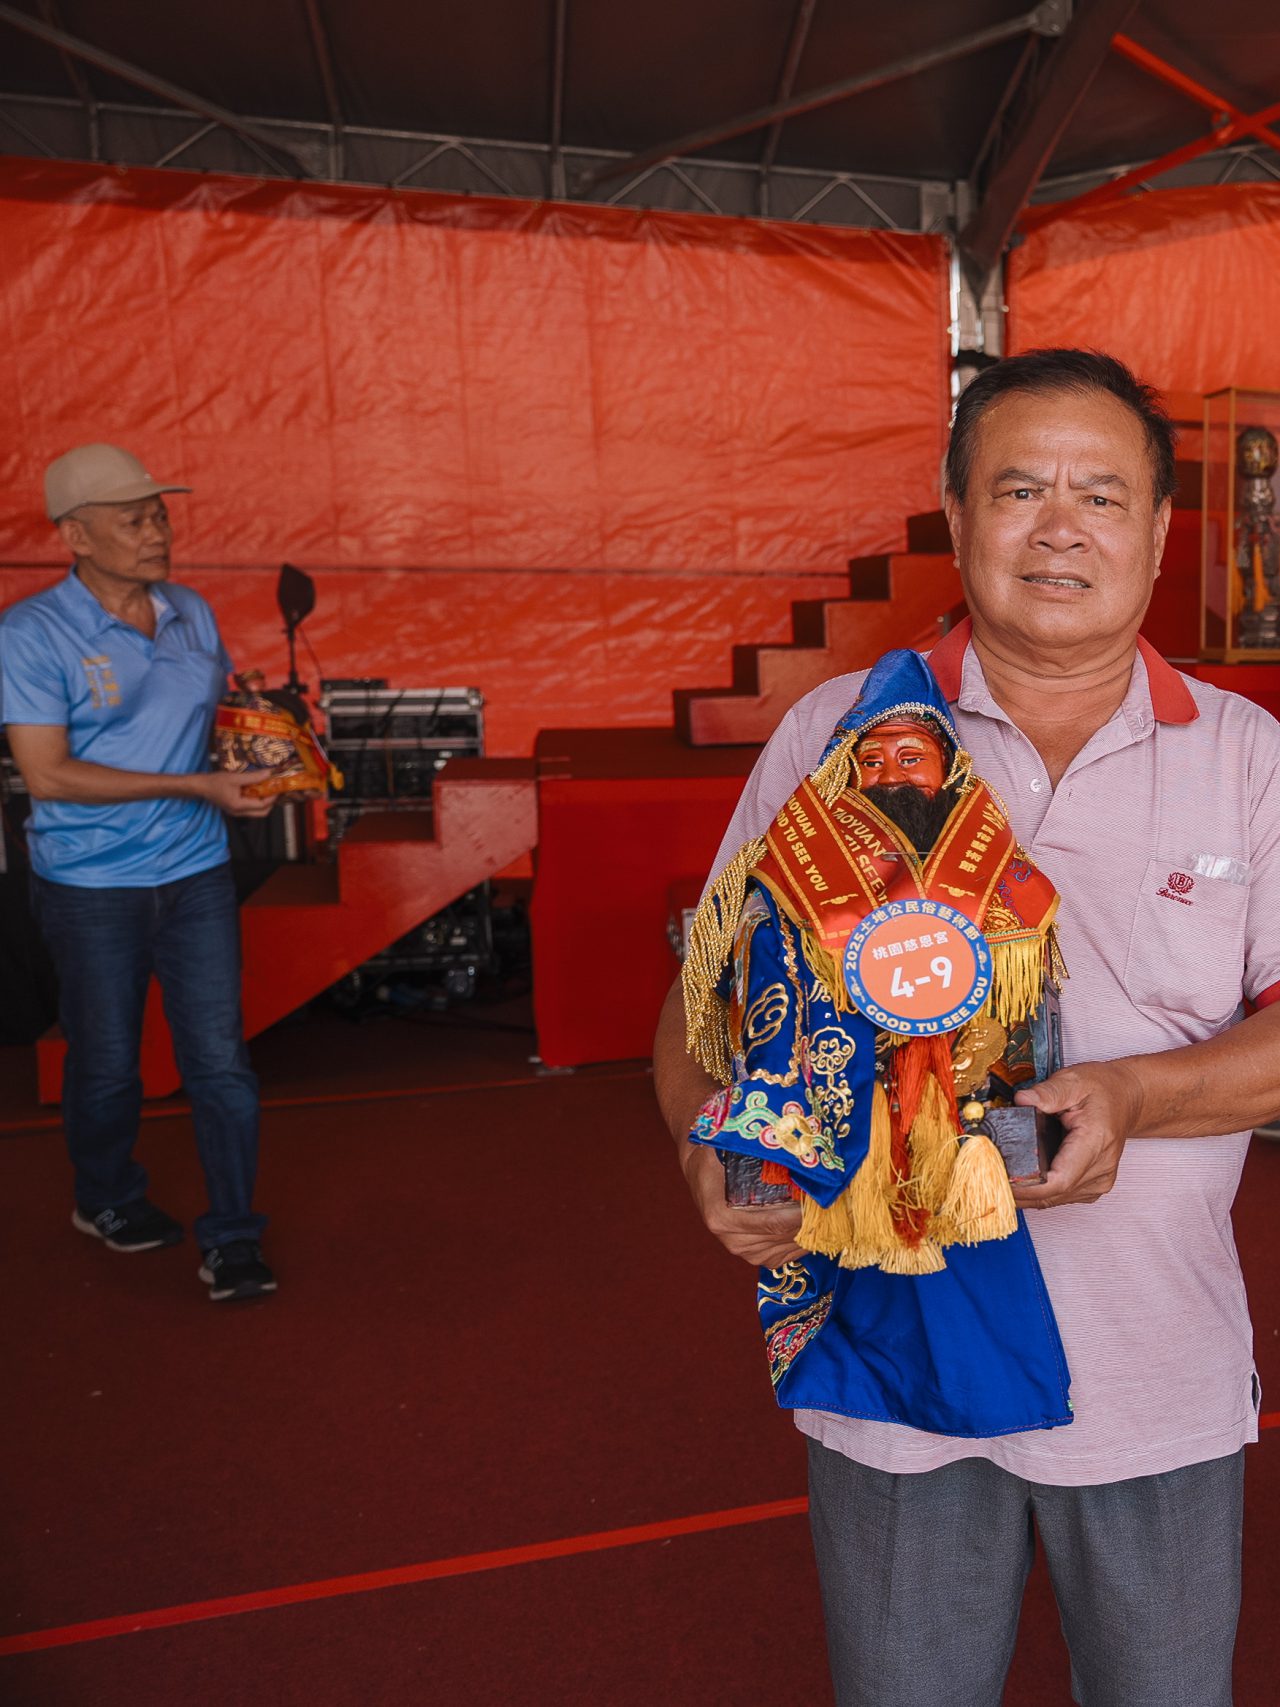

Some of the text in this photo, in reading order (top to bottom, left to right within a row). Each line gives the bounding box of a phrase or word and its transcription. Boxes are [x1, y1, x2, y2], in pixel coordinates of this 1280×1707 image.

[832, 807, 887, 857] TAOYUAN
[783, 826, 799, 842] TU
[791, 842, 812, 865] SEE
[805, 864, 829, 892] YOU
[872, 931, 949, 960] 桃園慈恩宮
[891, 956, 953, 998] 4-9
[866, 977, 988, 1033] GOOD TU SEE YOU
